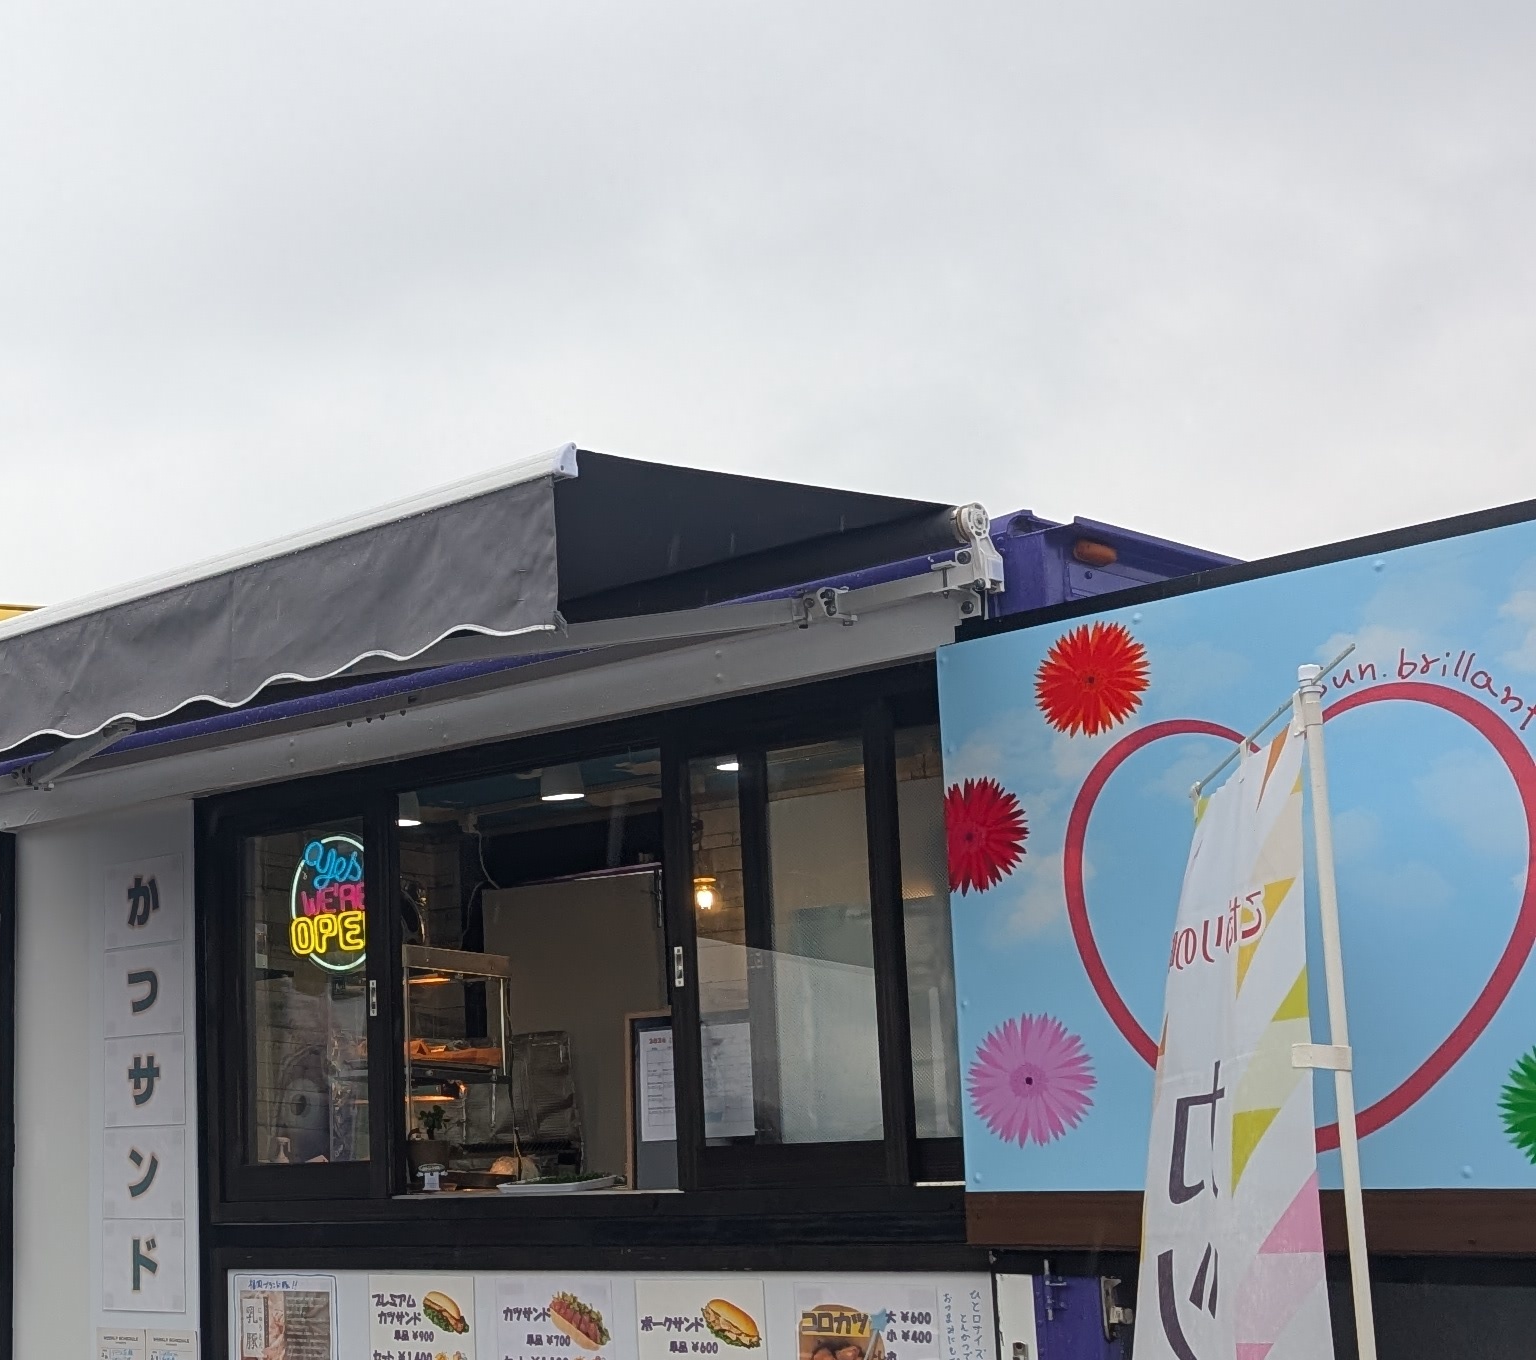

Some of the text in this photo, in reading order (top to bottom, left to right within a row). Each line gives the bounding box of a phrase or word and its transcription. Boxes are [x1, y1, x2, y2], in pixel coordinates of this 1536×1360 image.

[1319, 648, 1536, 730] un.brillant
[305, 841, 362, 889] Yes
[291, 910, 366, 954] OPE
[372, 1293, 416, 1309] プレミアム
[377, 1310, 422, 1326] カツサンド
[502, 1306, 551, 1322] カツサンド
[900, 1311, 932, 1326] ¥600
[640, 1315, 704, 1333] ポークサンド
[412, 1330, 435, 1343] ¥900
[546, 1334, 571, 1348] ¥700
[900, 1330, 932, 1344] ¥400
[691, 1341, 719, 1355] ¥600
